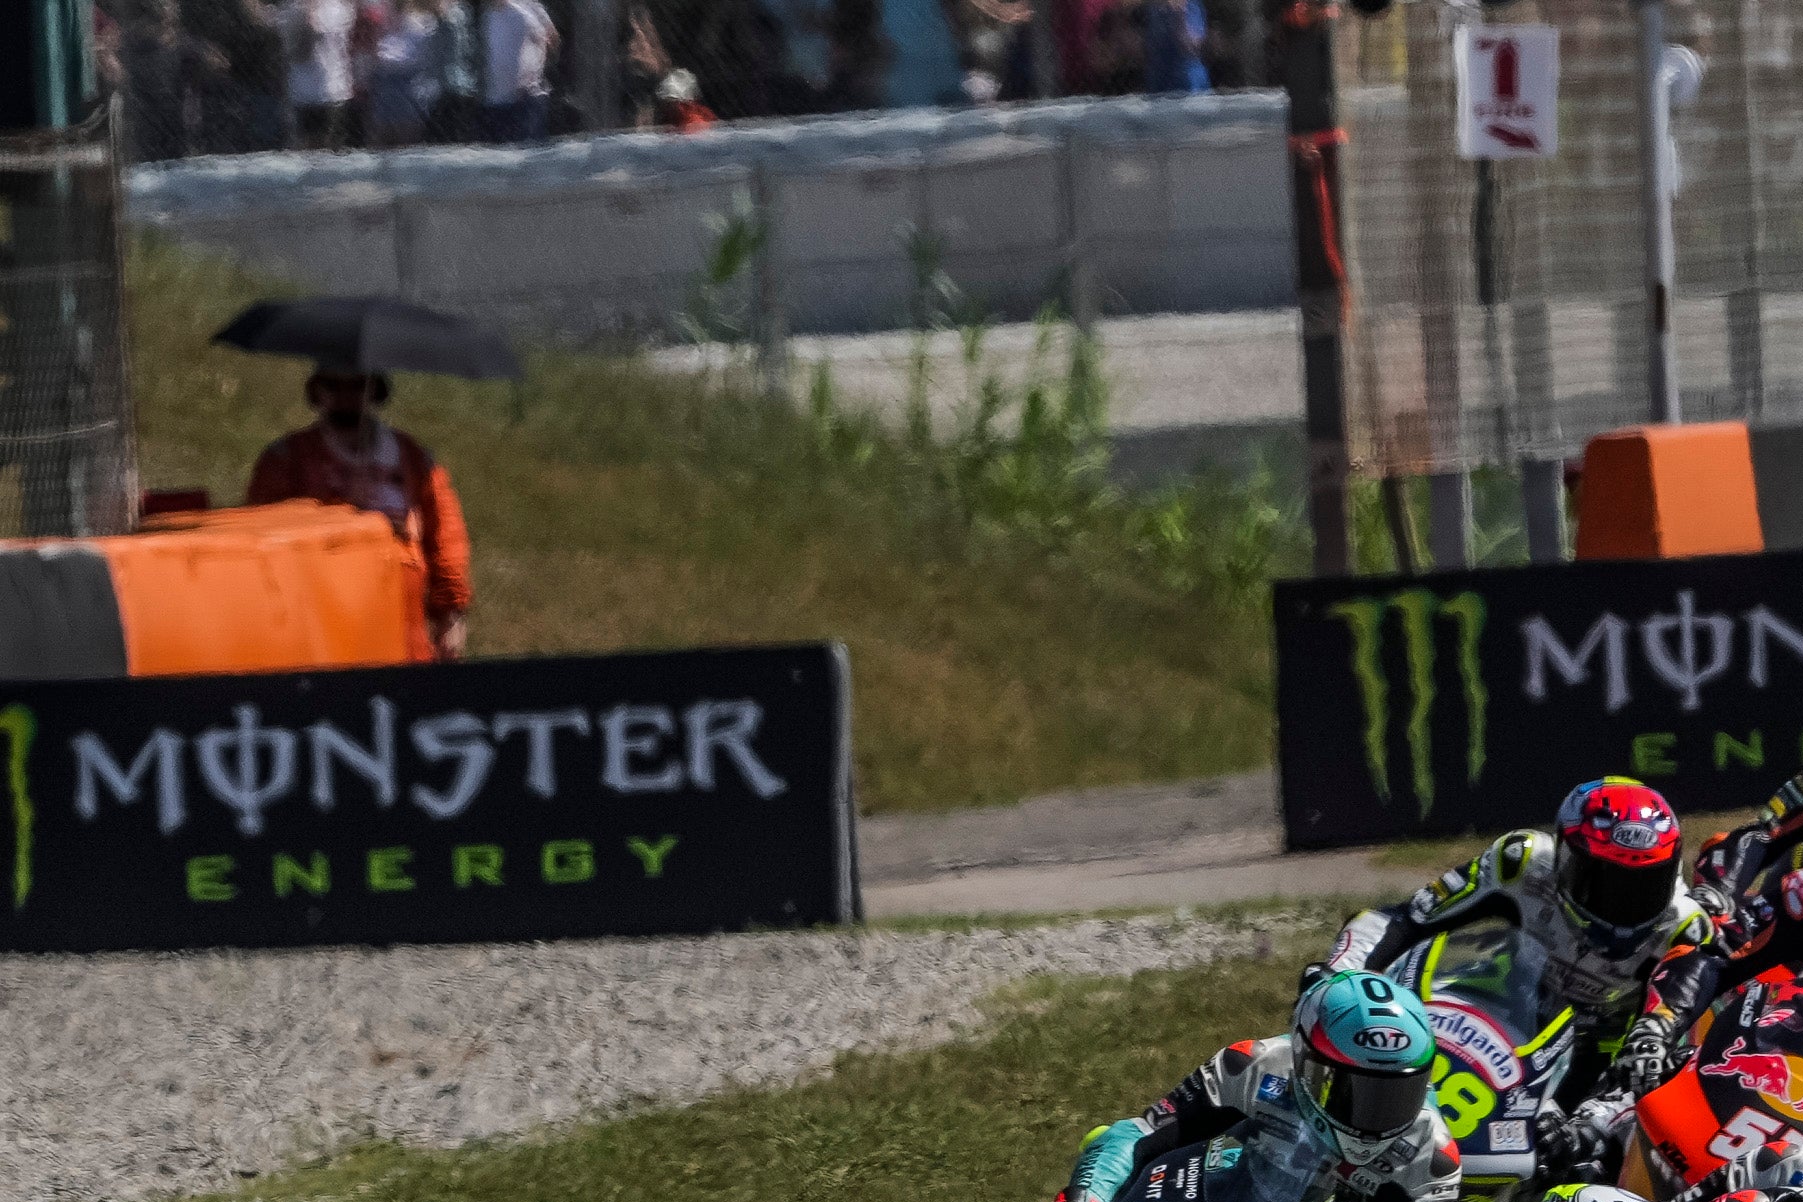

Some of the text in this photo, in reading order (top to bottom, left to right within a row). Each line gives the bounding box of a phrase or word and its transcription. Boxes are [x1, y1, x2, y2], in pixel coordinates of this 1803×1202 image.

[72, 694, 788, 837] MONSTER
[184, 834, 680, 902] ENERGY
[1146, 1164, 1168, 1199] DOVIT
[1185, 1157, 1200, 1200] ANONIMO
